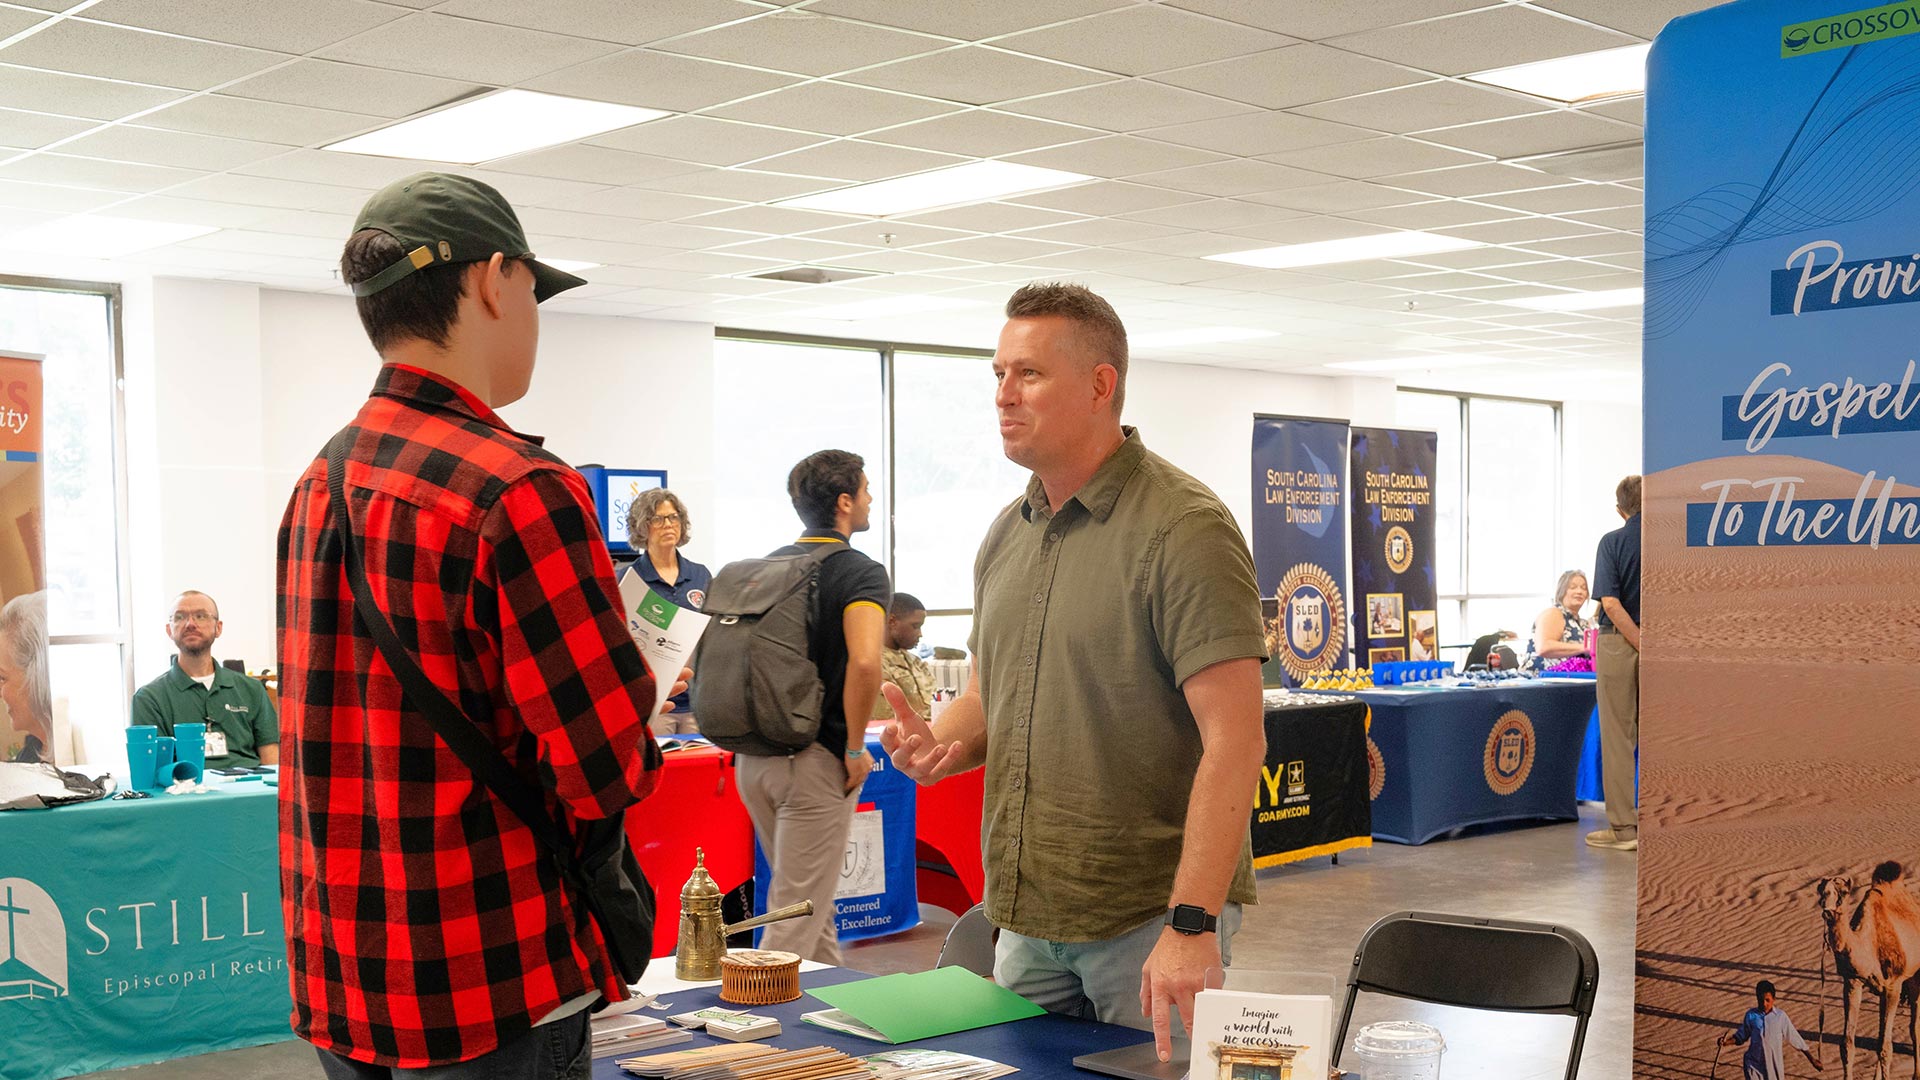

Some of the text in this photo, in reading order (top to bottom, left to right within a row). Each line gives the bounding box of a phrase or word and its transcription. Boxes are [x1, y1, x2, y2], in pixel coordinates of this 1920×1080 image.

[1738, 360, 1920, 453] Gospel
[1267, 469, 1338, 488] SOUTH CAROLINA
[1366, 471, 1429, 489] SOUTH CAROLINA
[1265, 487, 1340, 506] LAW ENFORCEMENT
[1365, 488, 1431, 505] LAW ENFORCEMENT
[1286, 506, 1322, 524] DIVISION
[1382, 505, 1415, 522] DIVISION
[1700, 479, 1751, 546] To
[1751, 476, 1844, 546] The
[1296, 604, 1319, 616] SLED
[1258, 805, 1310, 823] GOARMY.COM
[836, 897, 880, 915] Centered
[86, 892, 265, 956] STILL
[841, 915, 892, 930] Excellence
[104, 957, 289, 996] Episcopal Retir
[1241, 1007, 1280, 1020] Imagine
[1224, 1019, 1293, 1037] a world with
[1223, 1034, 1238, 1044] no
